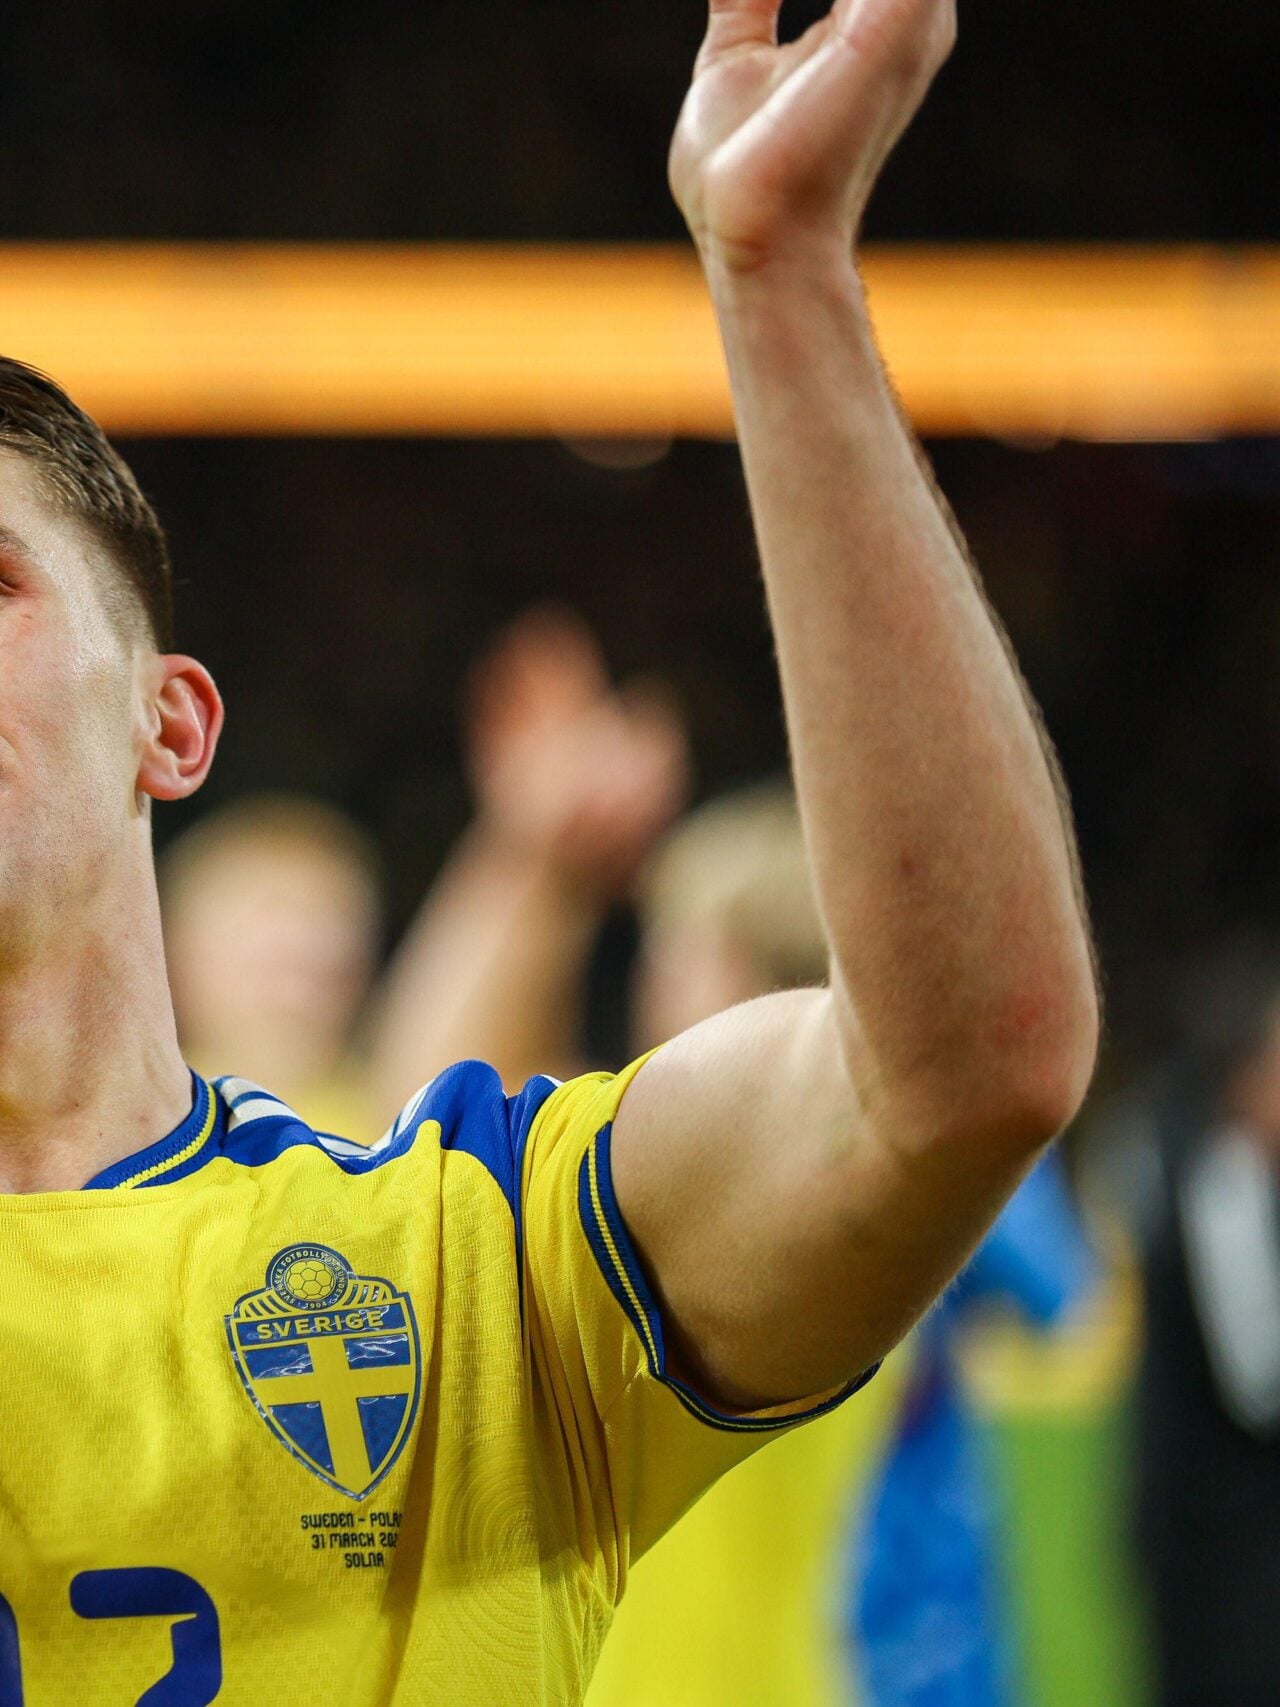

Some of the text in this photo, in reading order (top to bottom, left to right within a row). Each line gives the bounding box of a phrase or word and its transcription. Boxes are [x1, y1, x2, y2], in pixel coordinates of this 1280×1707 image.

[274, 1268, 295, 1304] SVENSKA
[256, 1310, 384, 1339] SVERIGE
[301, 1512, 355, 1530] SWEDEN
[312, 1534, 326, 1549] 31
[329, 1533, 375, 1549] MARCH
[344, 1552, 384, 1568] SOLNA
